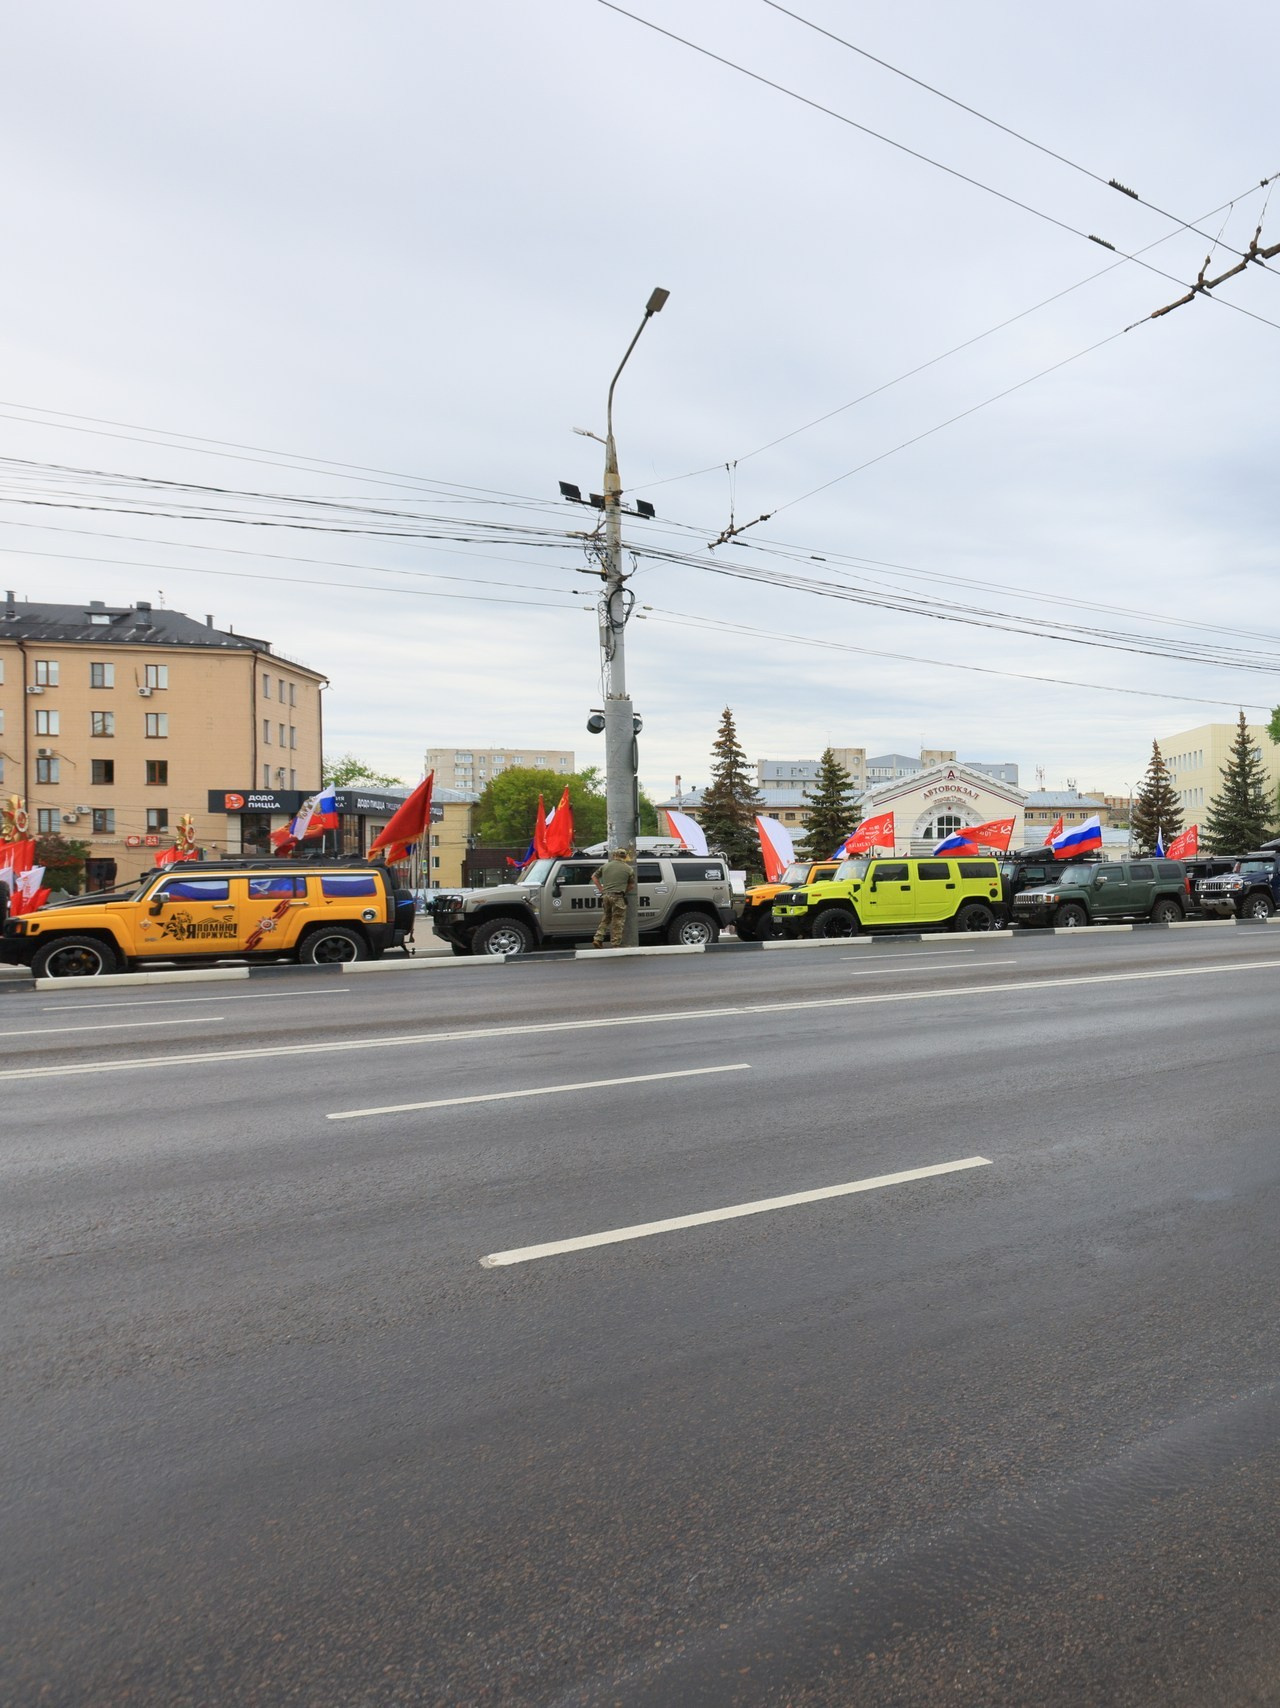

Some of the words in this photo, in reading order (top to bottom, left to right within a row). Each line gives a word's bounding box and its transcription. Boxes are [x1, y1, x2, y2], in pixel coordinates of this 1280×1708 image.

[248, 794, 274, 802] ДОДО
[922, 784, 980, 800] АВТОВОКЗАЛ
[147, 836, 157, 845] 24
[186, 923, 196, 939] Я
